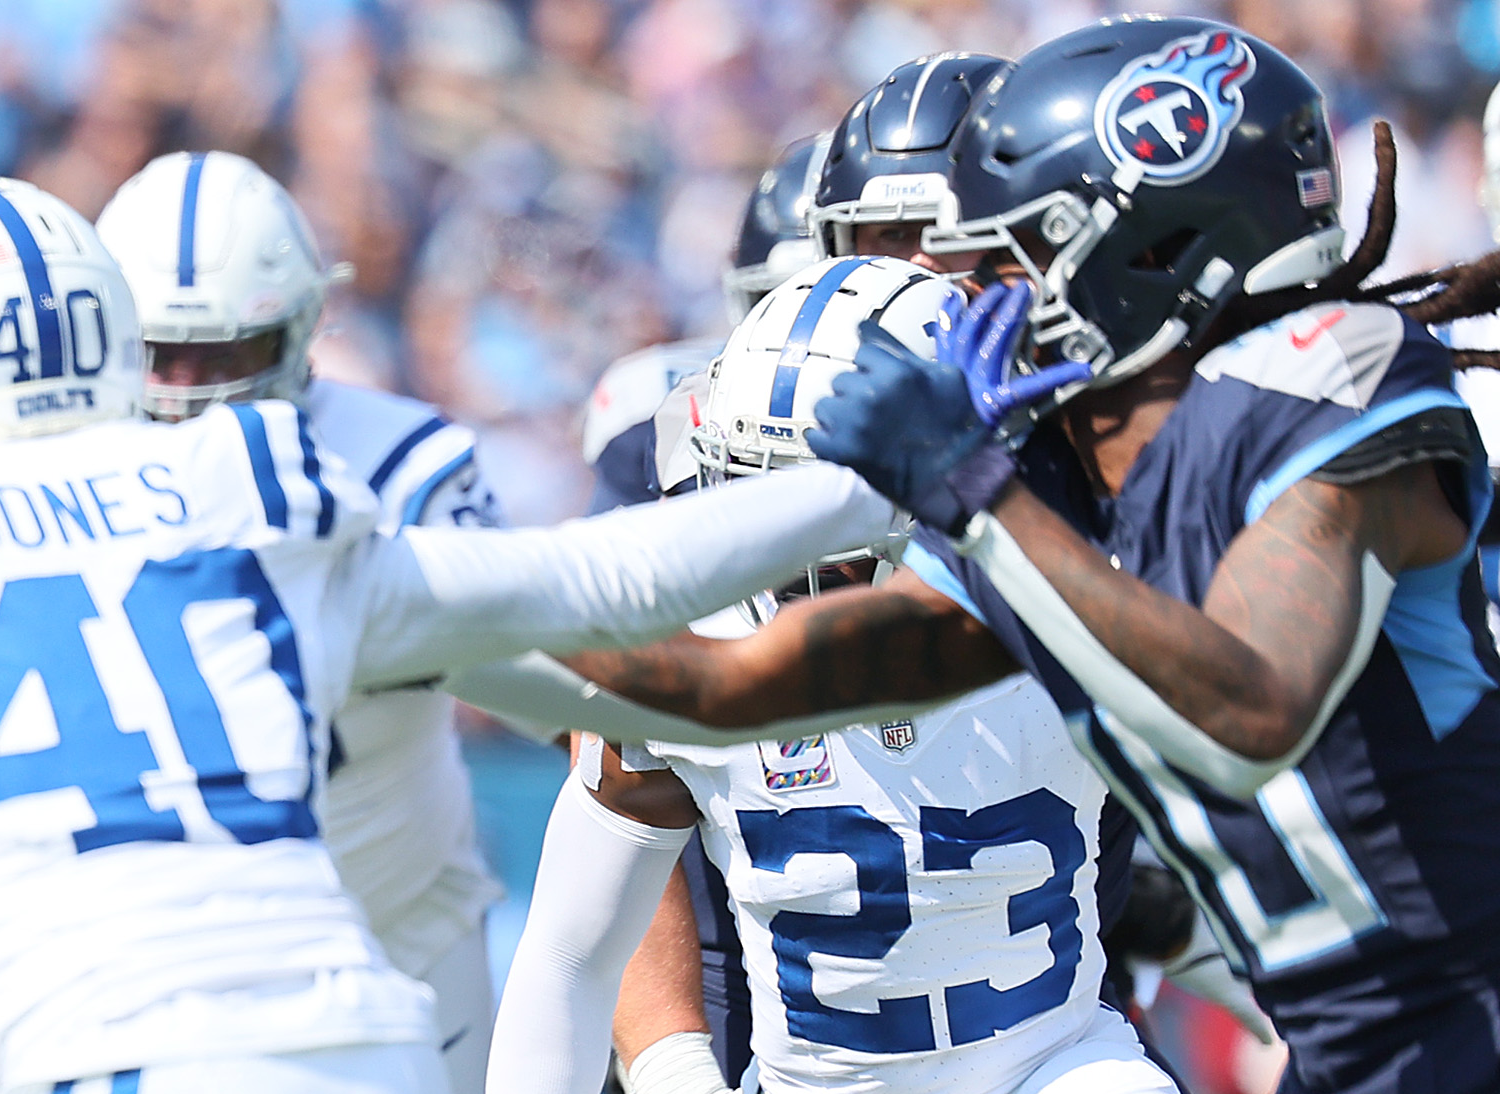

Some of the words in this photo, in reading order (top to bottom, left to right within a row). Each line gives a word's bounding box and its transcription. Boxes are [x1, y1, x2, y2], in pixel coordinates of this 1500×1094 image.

[760, 424, 794, 439] COLTS
[885, 726, 913, 747] NFL
[734, 786, 1088, 1055] 23
